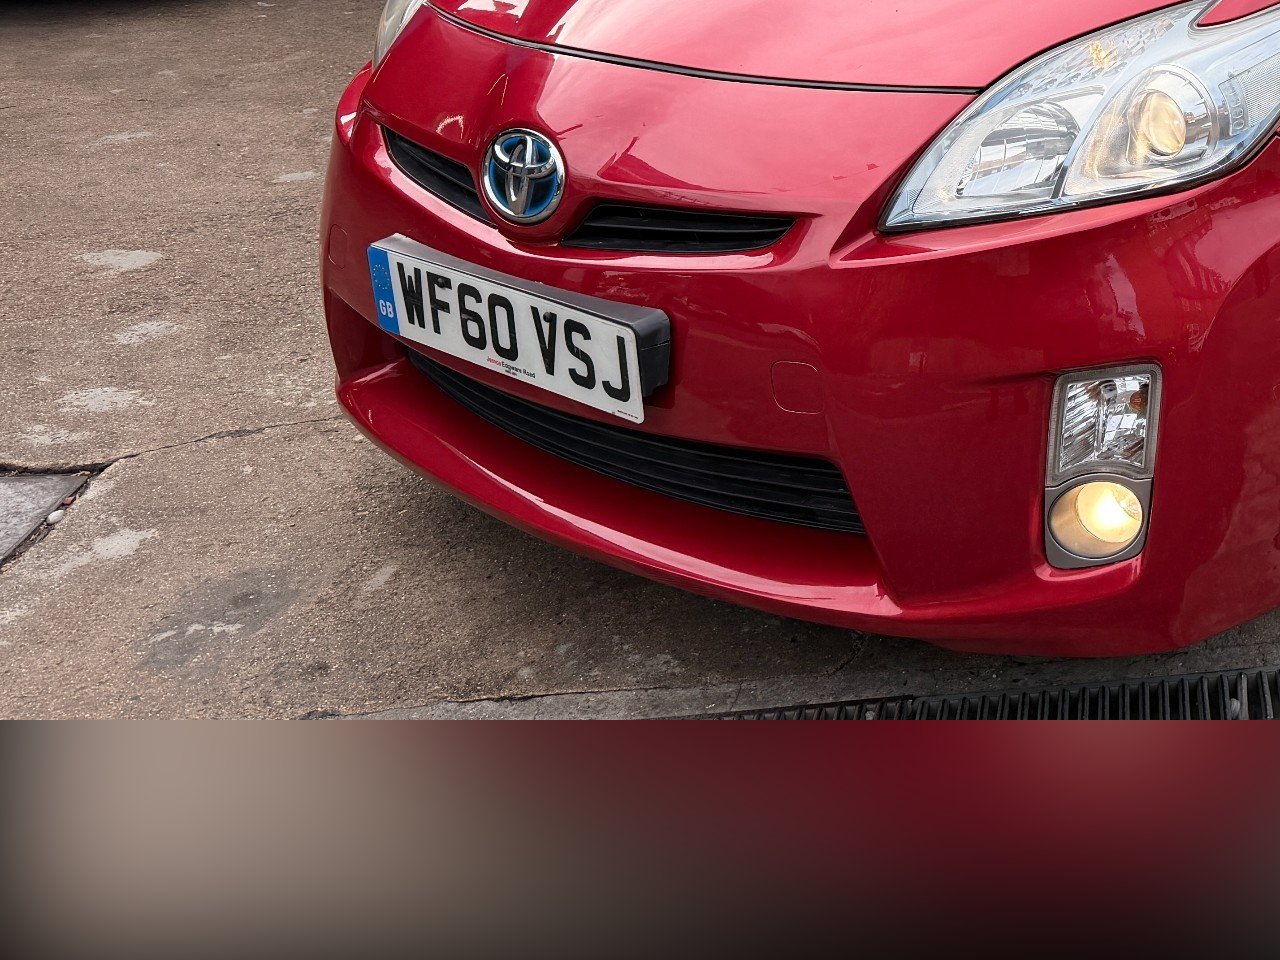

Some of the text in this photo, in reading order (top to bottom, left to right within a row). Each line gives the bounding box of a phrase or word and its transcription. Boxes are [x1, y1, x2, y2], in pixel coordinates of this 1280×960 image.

[379, 299, 394, 318] GB
[396, 261, 631, 403] WF60 VSJ
